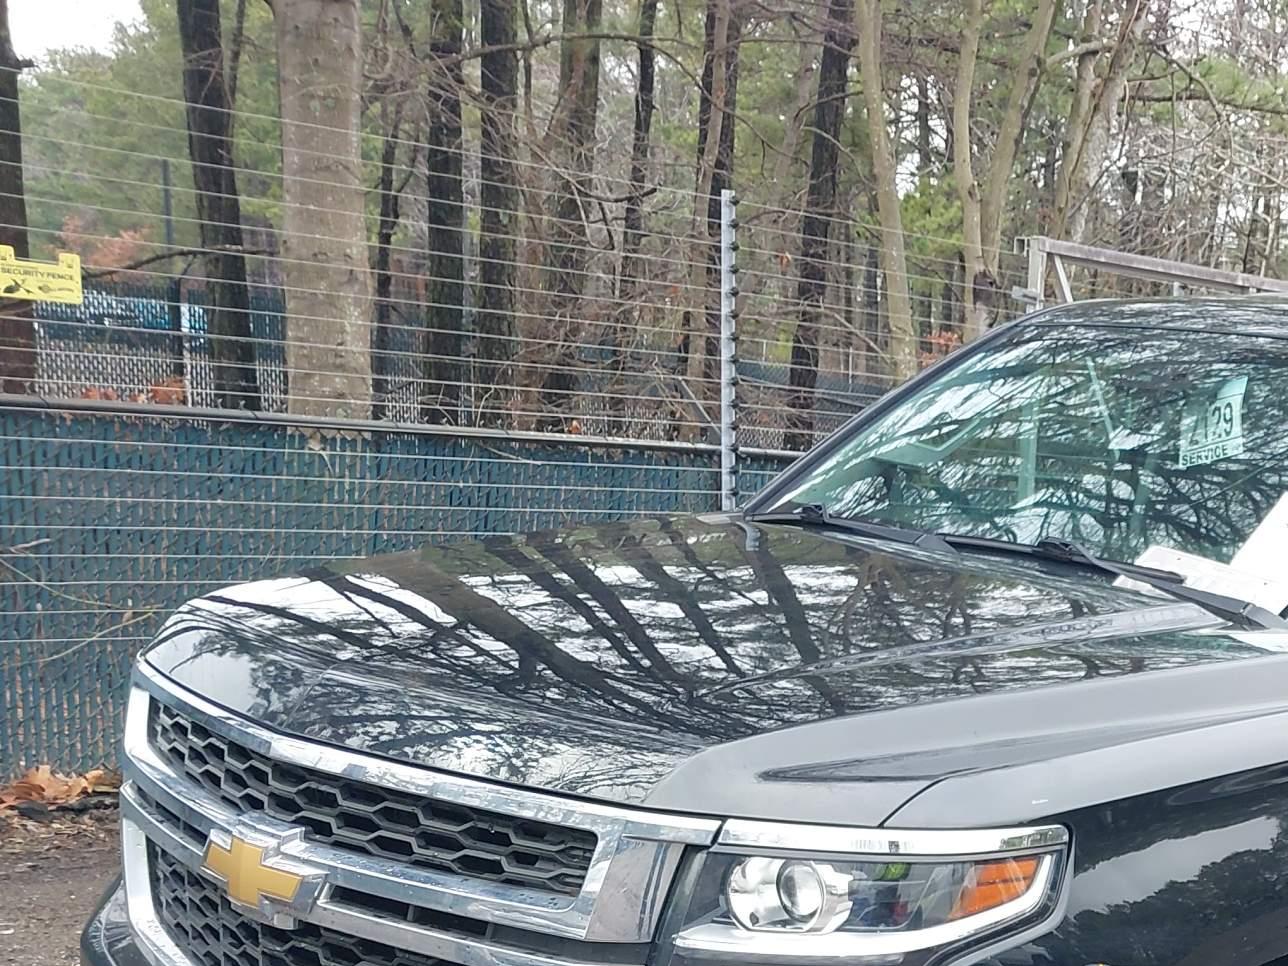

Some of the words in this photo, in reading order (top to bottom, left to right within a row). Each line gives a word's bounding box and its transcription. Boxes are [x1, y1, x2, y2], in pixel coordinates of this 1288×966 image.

[1, 266, 45, 278] SECURITY
[46, 271, 75, 281] FENCE
[1181, 443, 1229, 467] SERVICE
